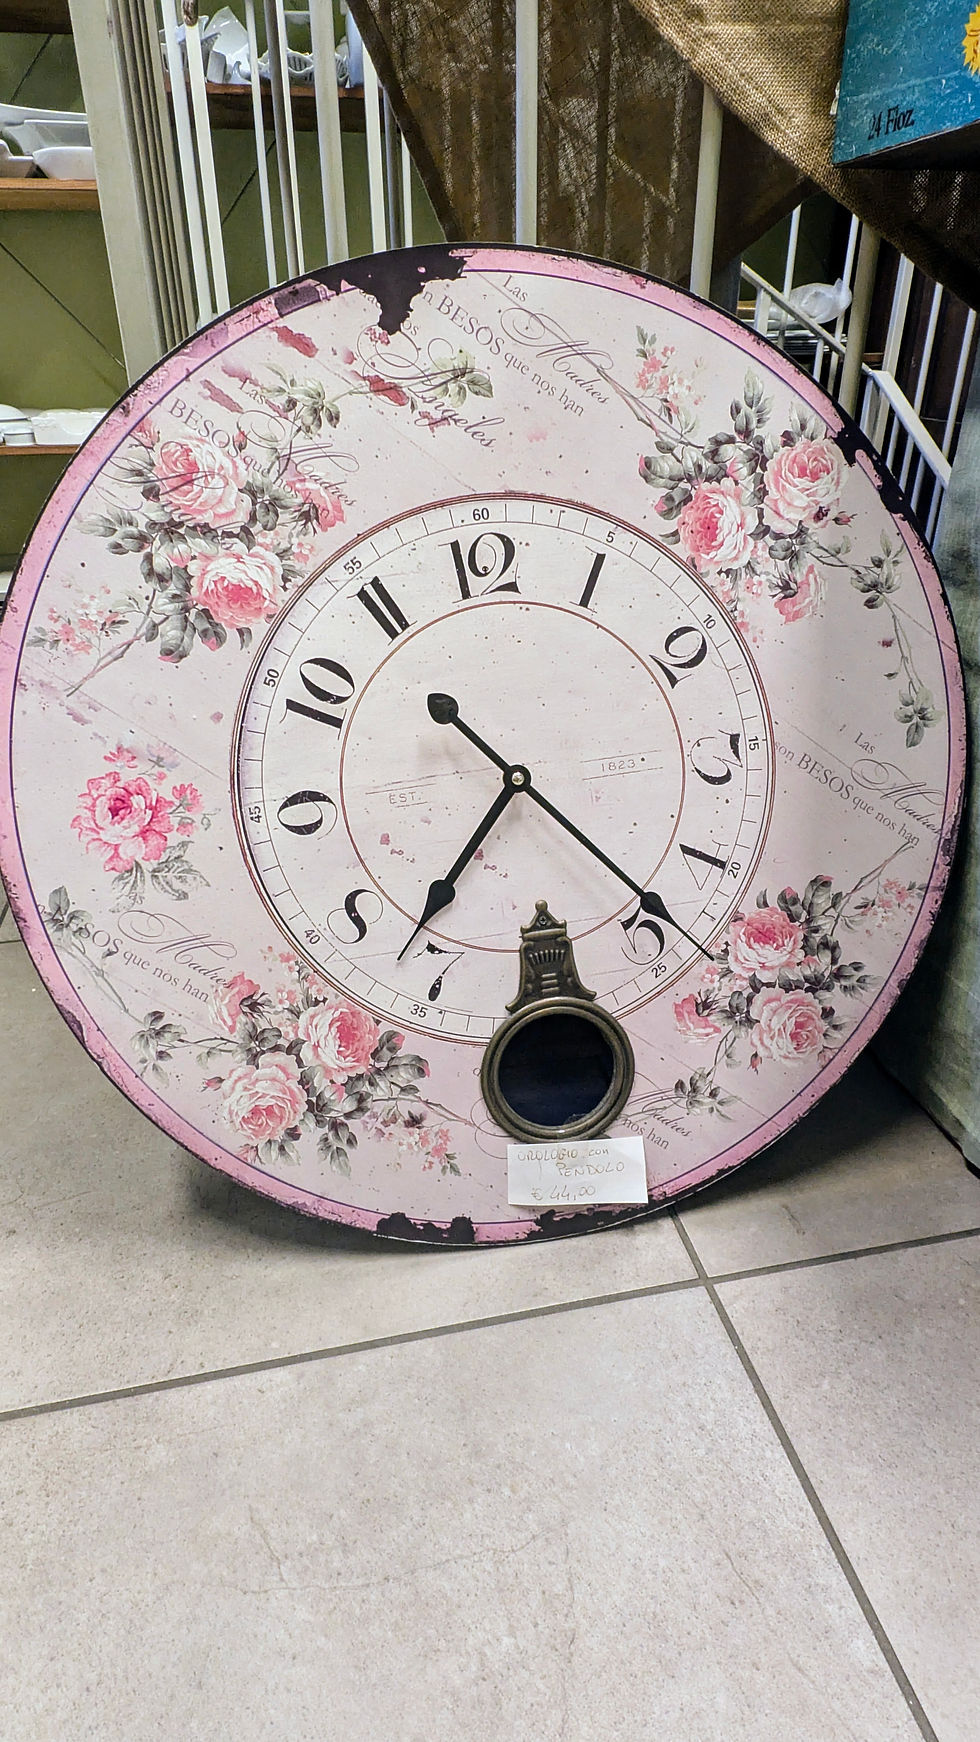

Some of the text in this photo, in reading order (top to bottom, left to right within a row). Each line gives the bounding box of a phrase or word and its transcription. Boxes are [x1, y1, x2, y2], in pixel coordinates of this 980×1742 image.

[867, 111, 883, 140] 24
[502, 274, 529, 302] Las
[436, 294, 505, 355] BESOS
[504, 352, 530, 376] que
[531, 372, 557, 396] nos
[557, 388, 584, 417] han
[238, 377, 266, 405] Las
[167, 397, 240, 458] BESOS
[242, 452, 271, 476] que
[472, 507, 490, 521] 60
[606, 530, 617, 544] 5
[343, 556, 363, 576] 55
[438, 532, 522, 604] 12
[569, 546, 607, 614] 1
[346, 575, 418, 646] 11
[703, 613, 717, 630] 10
[649, 626, 708, 690] 2
[263, 668, 280, 688] 50
[279, 657, 355, 741] 10
[690, 729, 743, 786] 3
[748, 735, 760, 751] 15
[854, 732, 876, 755] Las
[248, 805, 262, 824] 45
[277, 790, 338, 841] 9
[796, 753, 855, 800] BESOS
[852, 795, 875, 815] que
[874, 811, 897, 831] nos
[897, 823, 921, 846] han
[679, 839, 729, 891] 4
[727, 861, 741, 880] 20
[326, 888, 384, 945] 8
[304, 929, 321, 945] 40
[619, 905, 665, 966] 5
[123, 950, 150, 971] que
[151, 966, 179, 988] nos
[181, 977, 209, 1002] han
[412, 940, 466, 1002] 7
[650, 961, 668, 979] 25
[409, 1003, 429, 1018] 35
[623, 1117, 670, 1150] nos han
